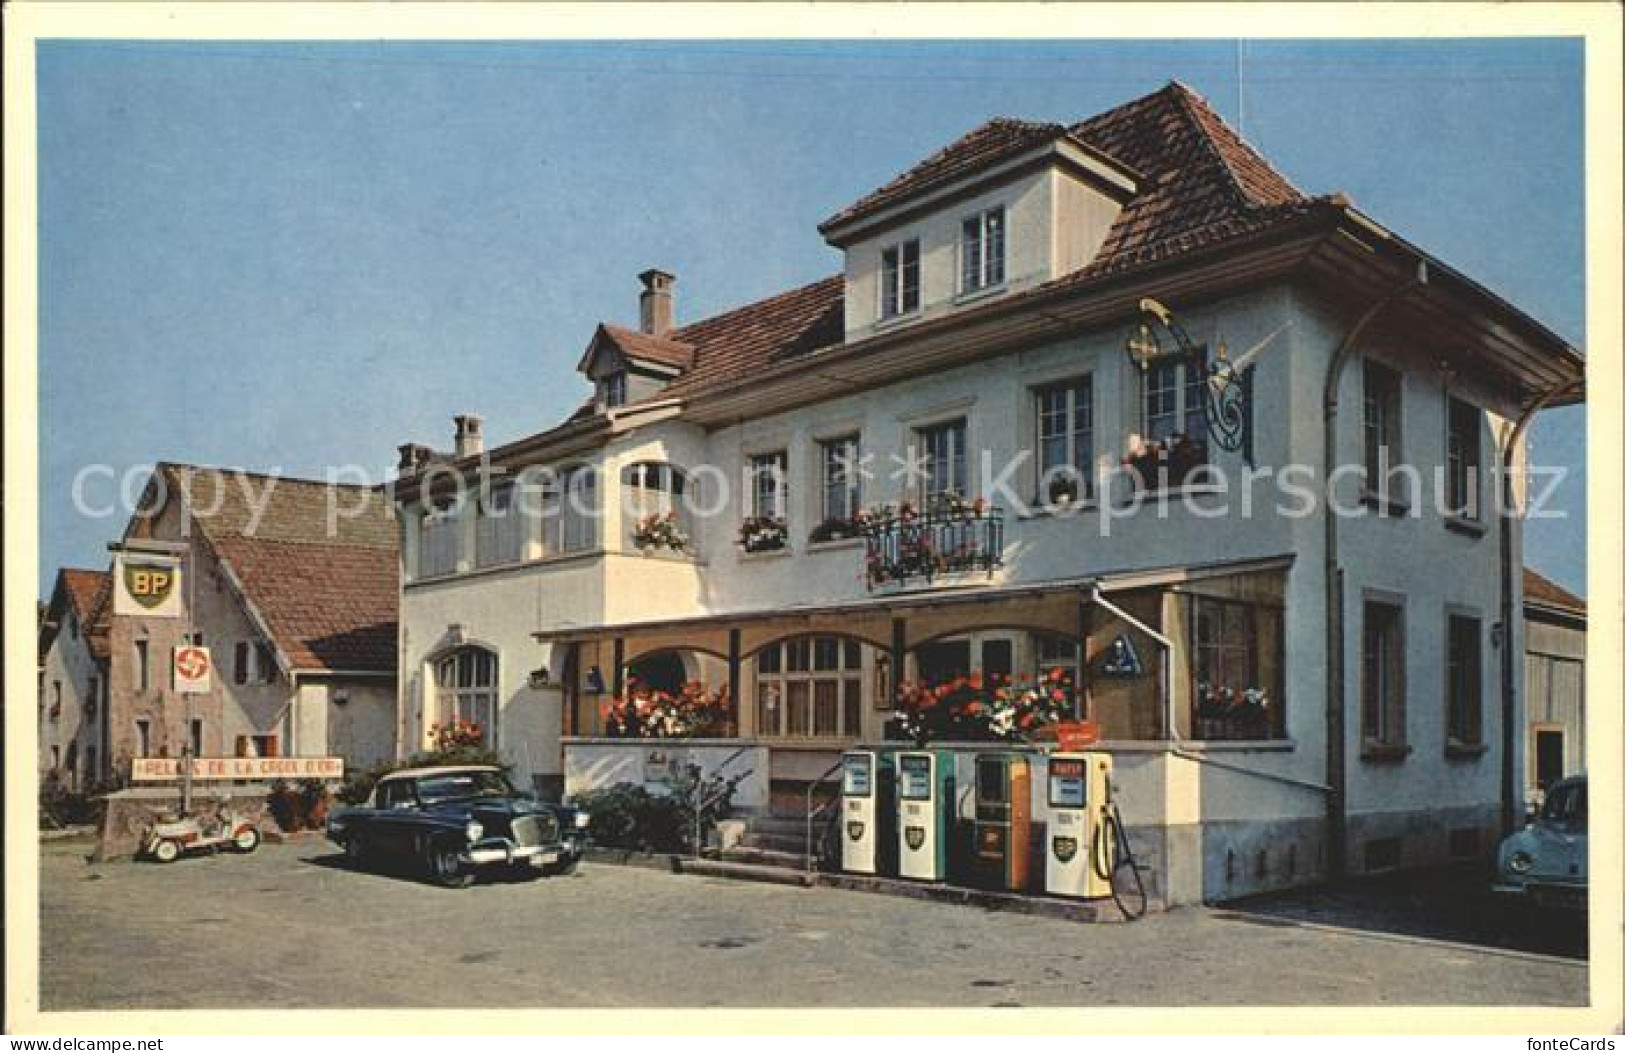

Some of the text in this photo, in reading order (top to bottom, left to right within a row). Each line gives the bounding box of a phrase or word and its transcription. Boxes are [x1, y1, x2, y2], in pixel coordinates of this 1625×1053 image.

[132, 571, 167, 594] BP
[146, 760, 205, 775] RELS
[235, 760, 252, 775] LA
[1057, 840, 1075, 855] BP
